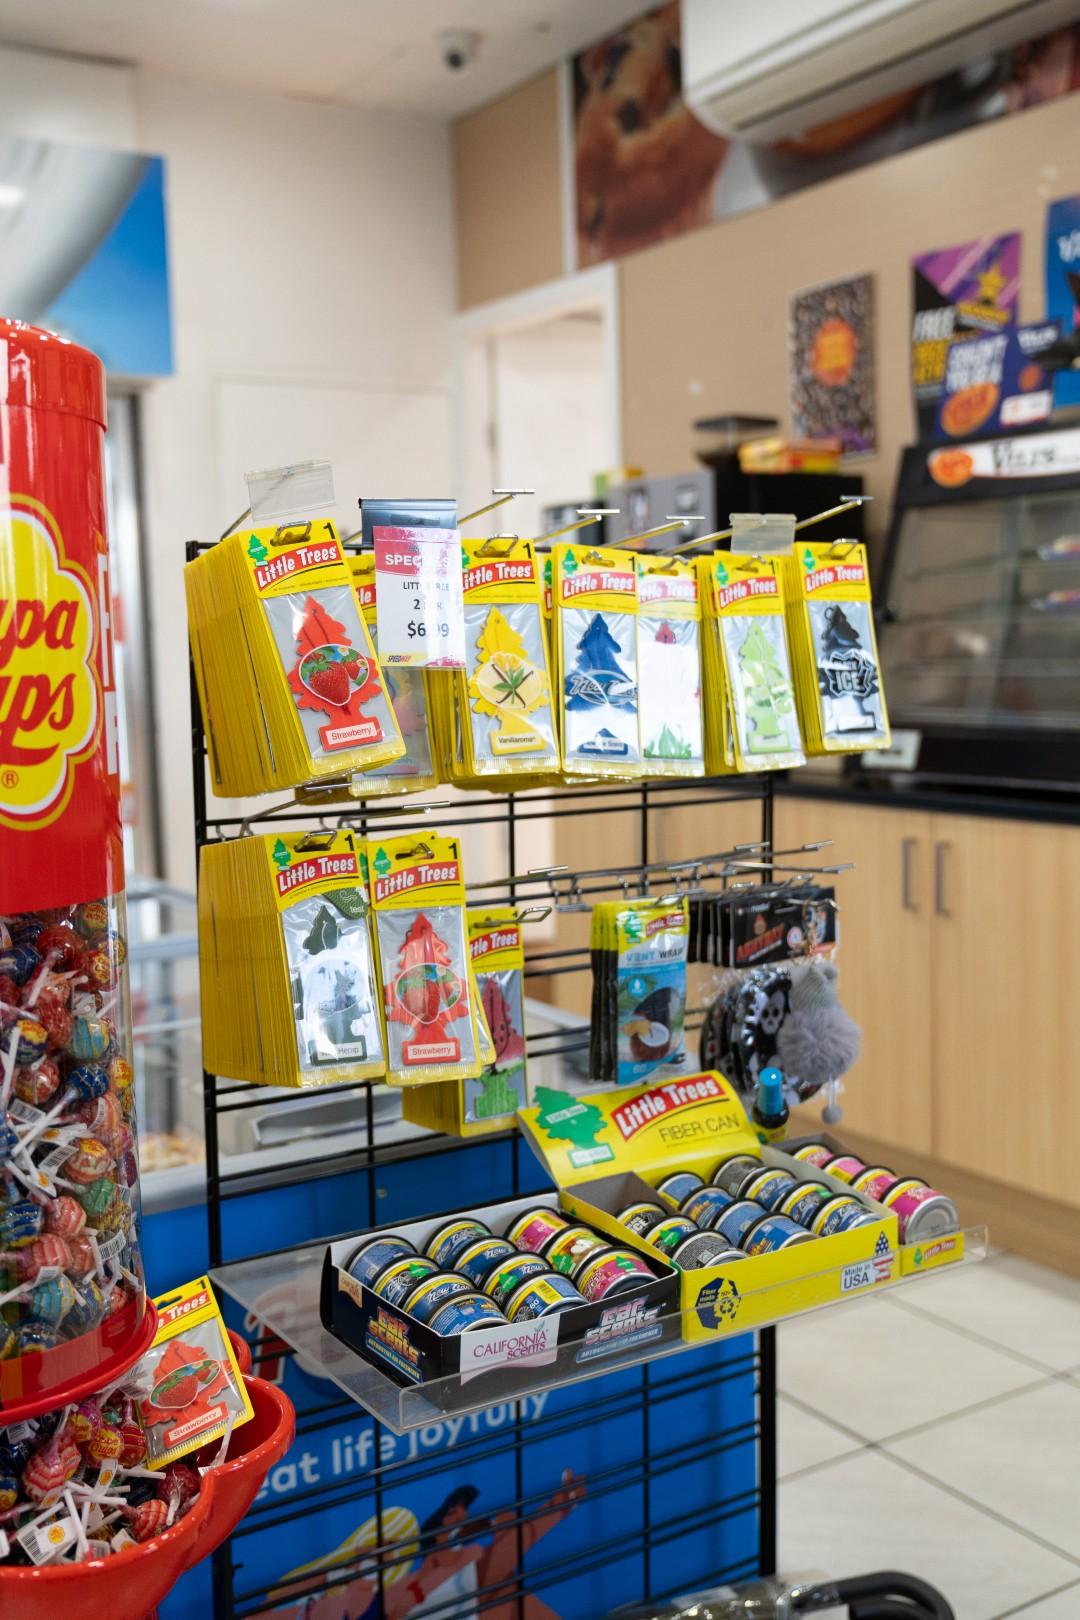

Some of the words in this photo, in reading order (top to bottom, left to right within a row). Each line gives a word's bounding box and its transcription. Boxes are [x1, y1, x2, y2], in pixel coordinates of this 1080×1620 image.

[323, 522, 336, 540] 1
[522, 542, 532, 559] 1
[257, 556, 295, 588] Little
[296, 546, 337, 566] Trees
[463, 566, 493, 592] ittle
[494, 562, 532, 580] Trees
[563, 575, 597, 599] Little
[600, 573, 633, 591] Trees
[806, 569, 834, 593] Little
[836, 565, 863, 581] Trees
[413, 598, 421, 610] 2
[719, 583, 746, 608] Little
[747, 578, 776, 594] Trees
[835, 671, 865, 691] ICE
[331, 726, 372, 741] Strawberry
[344, 834, 354, 851] 1
[448, 842, 458, 860] 1
[279, 862, 315, 892] Little
[317, 857, 354, 875] Trees
[376, 871, 414, 900] Little
[418, 865, 456, 883] Trees
[490, 931, 518, 949] Trees
[412, 1046, 451, 1057] Strawberry
[615, 1096, 666, 1137] Little
[662, 1079, 719, 1102] Trees
[658, 1121, 704, 1143] FIBER
[705, 1113, 741, 1132] CAN
[843, 1272, 869, 1289] USA
[844, 1265, 863, 1276] Made
[196, 1279, 206, 1290] 1
[166, 1293, 207, 1320] Trees
[473, 1331, 547, 1359] CALIFORNIA
[507, 1341, 546, 1360] scents
[173, 1410, 219, 1438] Strawberry
[332, 1428, 397, 1475] life
